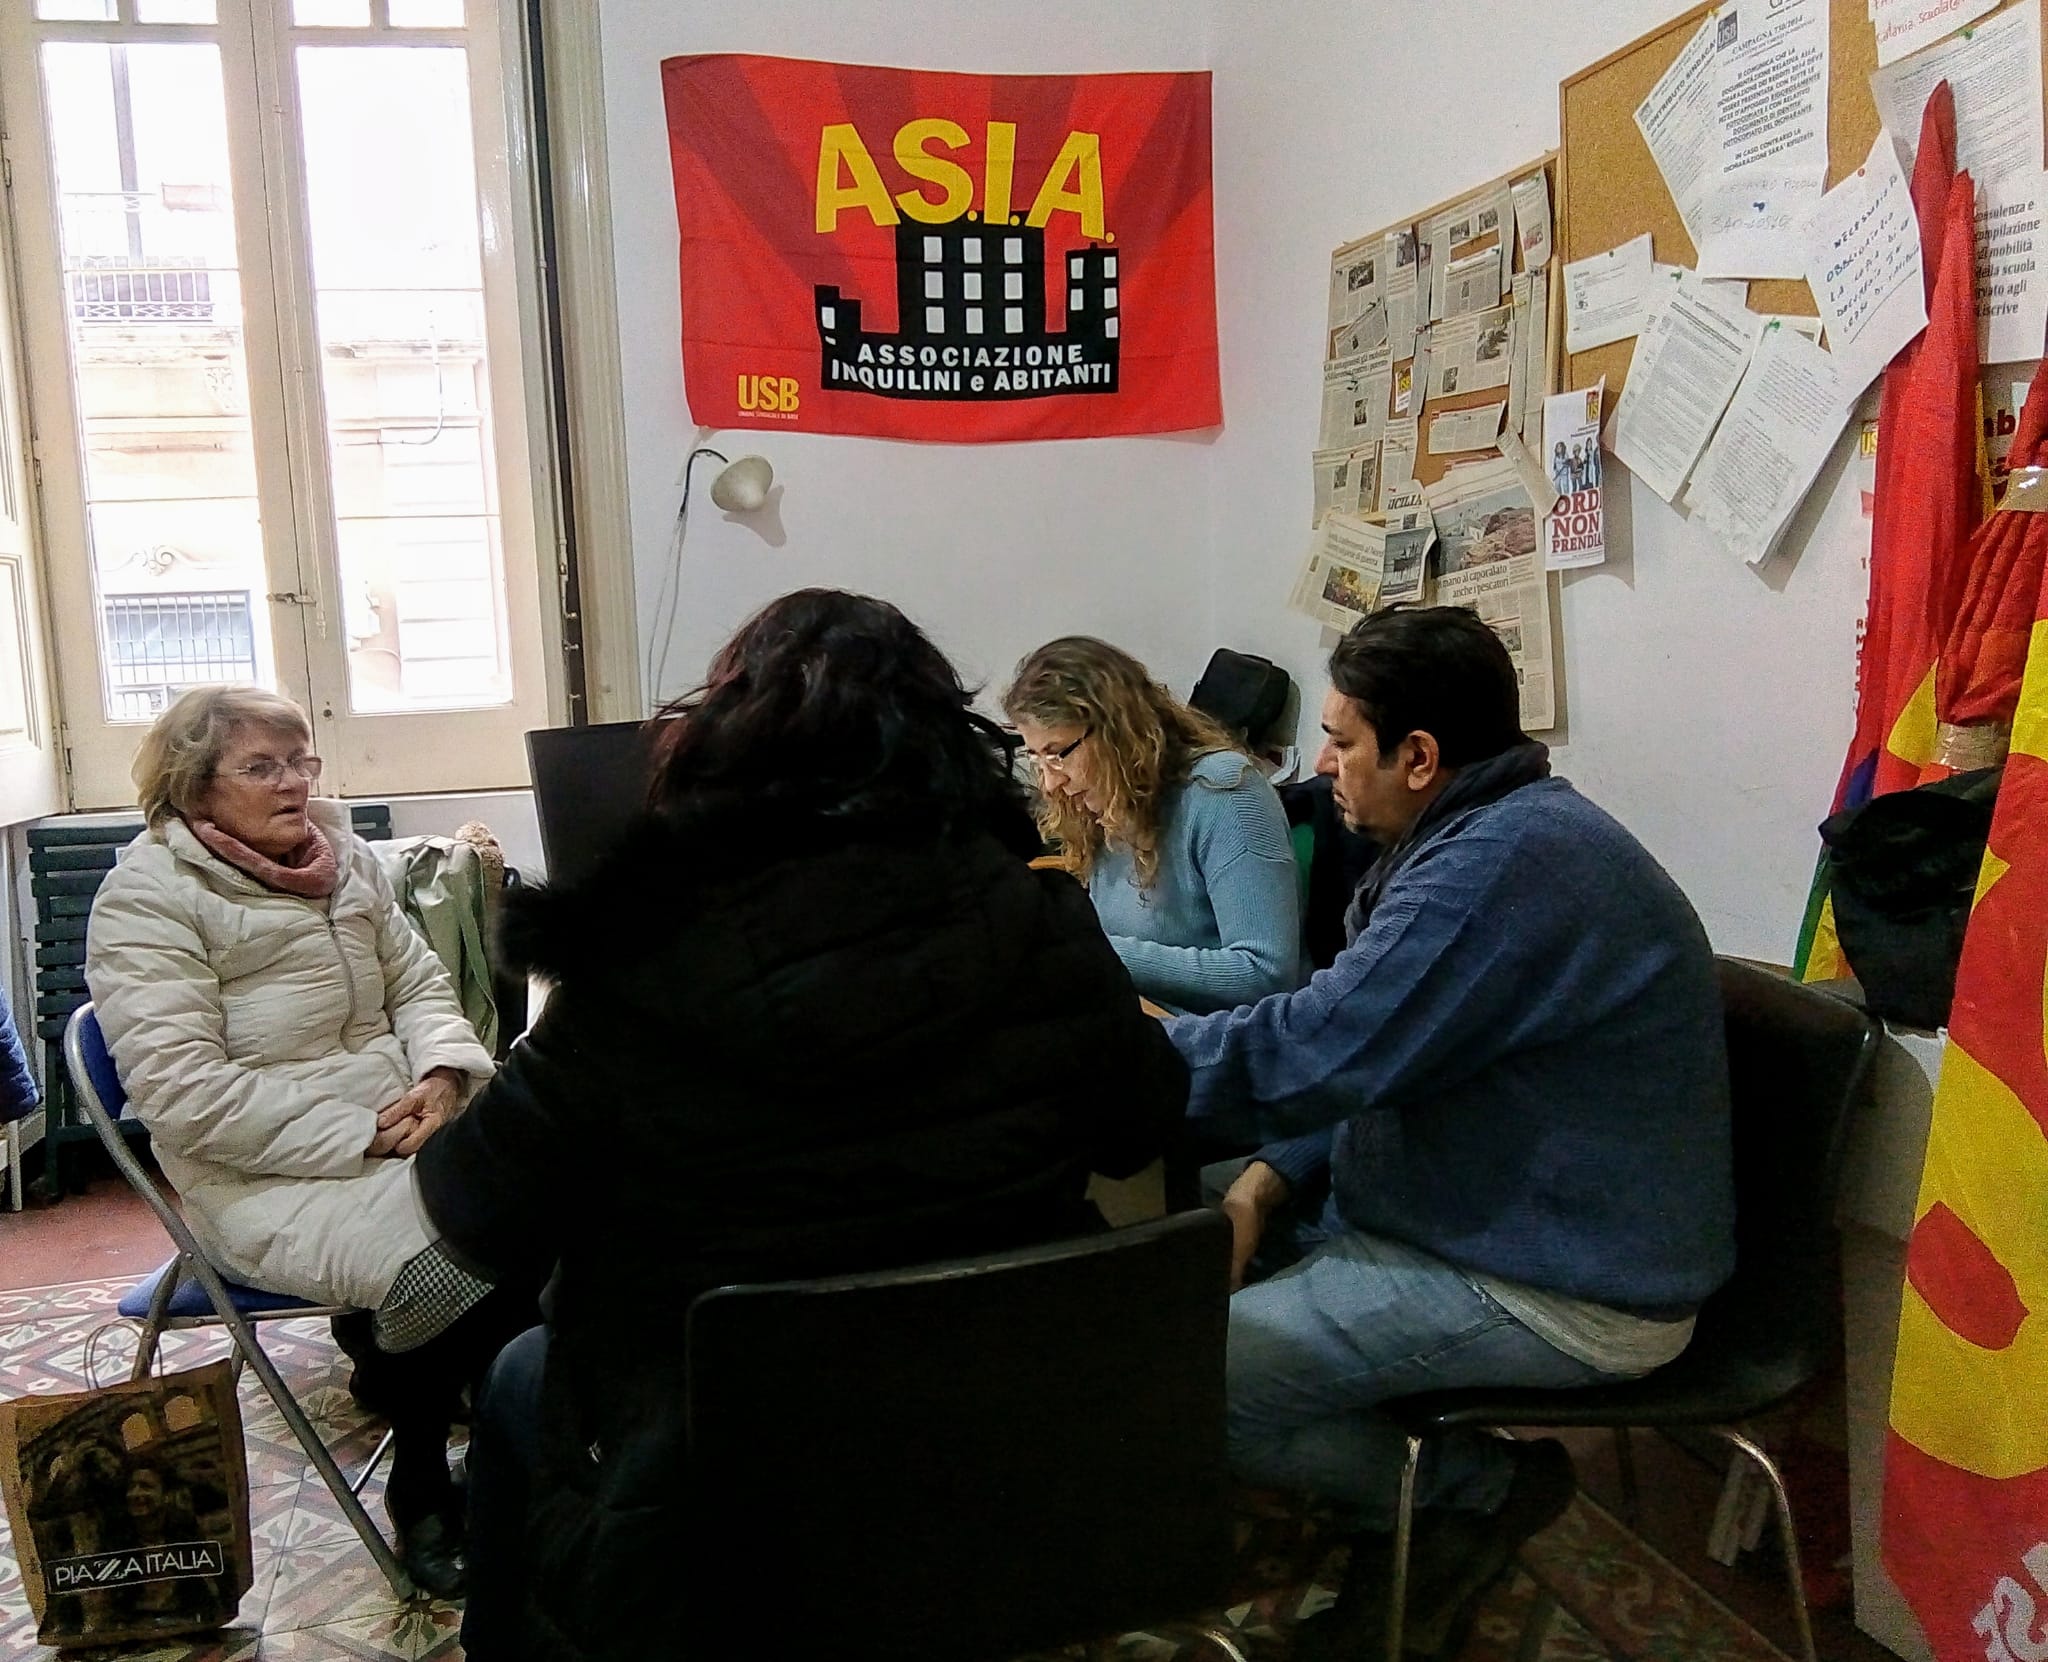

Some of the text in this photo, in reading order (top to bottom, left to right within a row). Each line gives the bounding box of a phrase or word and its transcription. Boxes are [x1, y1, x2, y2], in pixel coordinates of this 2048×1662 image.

[1743, 58, 1774, 77] COMUNICA
[1771, 55, 1799, 72] RELATIVA
[1800, 46, 1816, 59] ALLA
[1645, 79, 1686, 132] CONTRIBUTO
[1742, 145, 1759, 157] CASO
[1760, 130, 1793, 151] CONTRARIO
[1793, 127, 1802, 136] LA
[2028, 200, 2035, 210] e
[1989, 238, 2033, 258] mobilità
[2002, 258, 2036, 274] scuola
[2006, 279, 2028, 297] agli
[857, 343, 1083, 367] ASSOCIAZIONE
[832, 359, 1111, 392] INQUILINI e ABITANTI
[738, 375, 800, 412] USB
[1861, 432, 1878, 453] US
[1552, 512, 1601, 539] NON
[1442, 576, 1462, 588] mano
[1469, 564, 1508, 582] caporalato
[1452, 585, 1473, 598] anche
[1477, 576, 1509, 595] pescatori
[55, 1549, 215, 1586] PIAZZA ITALIA
